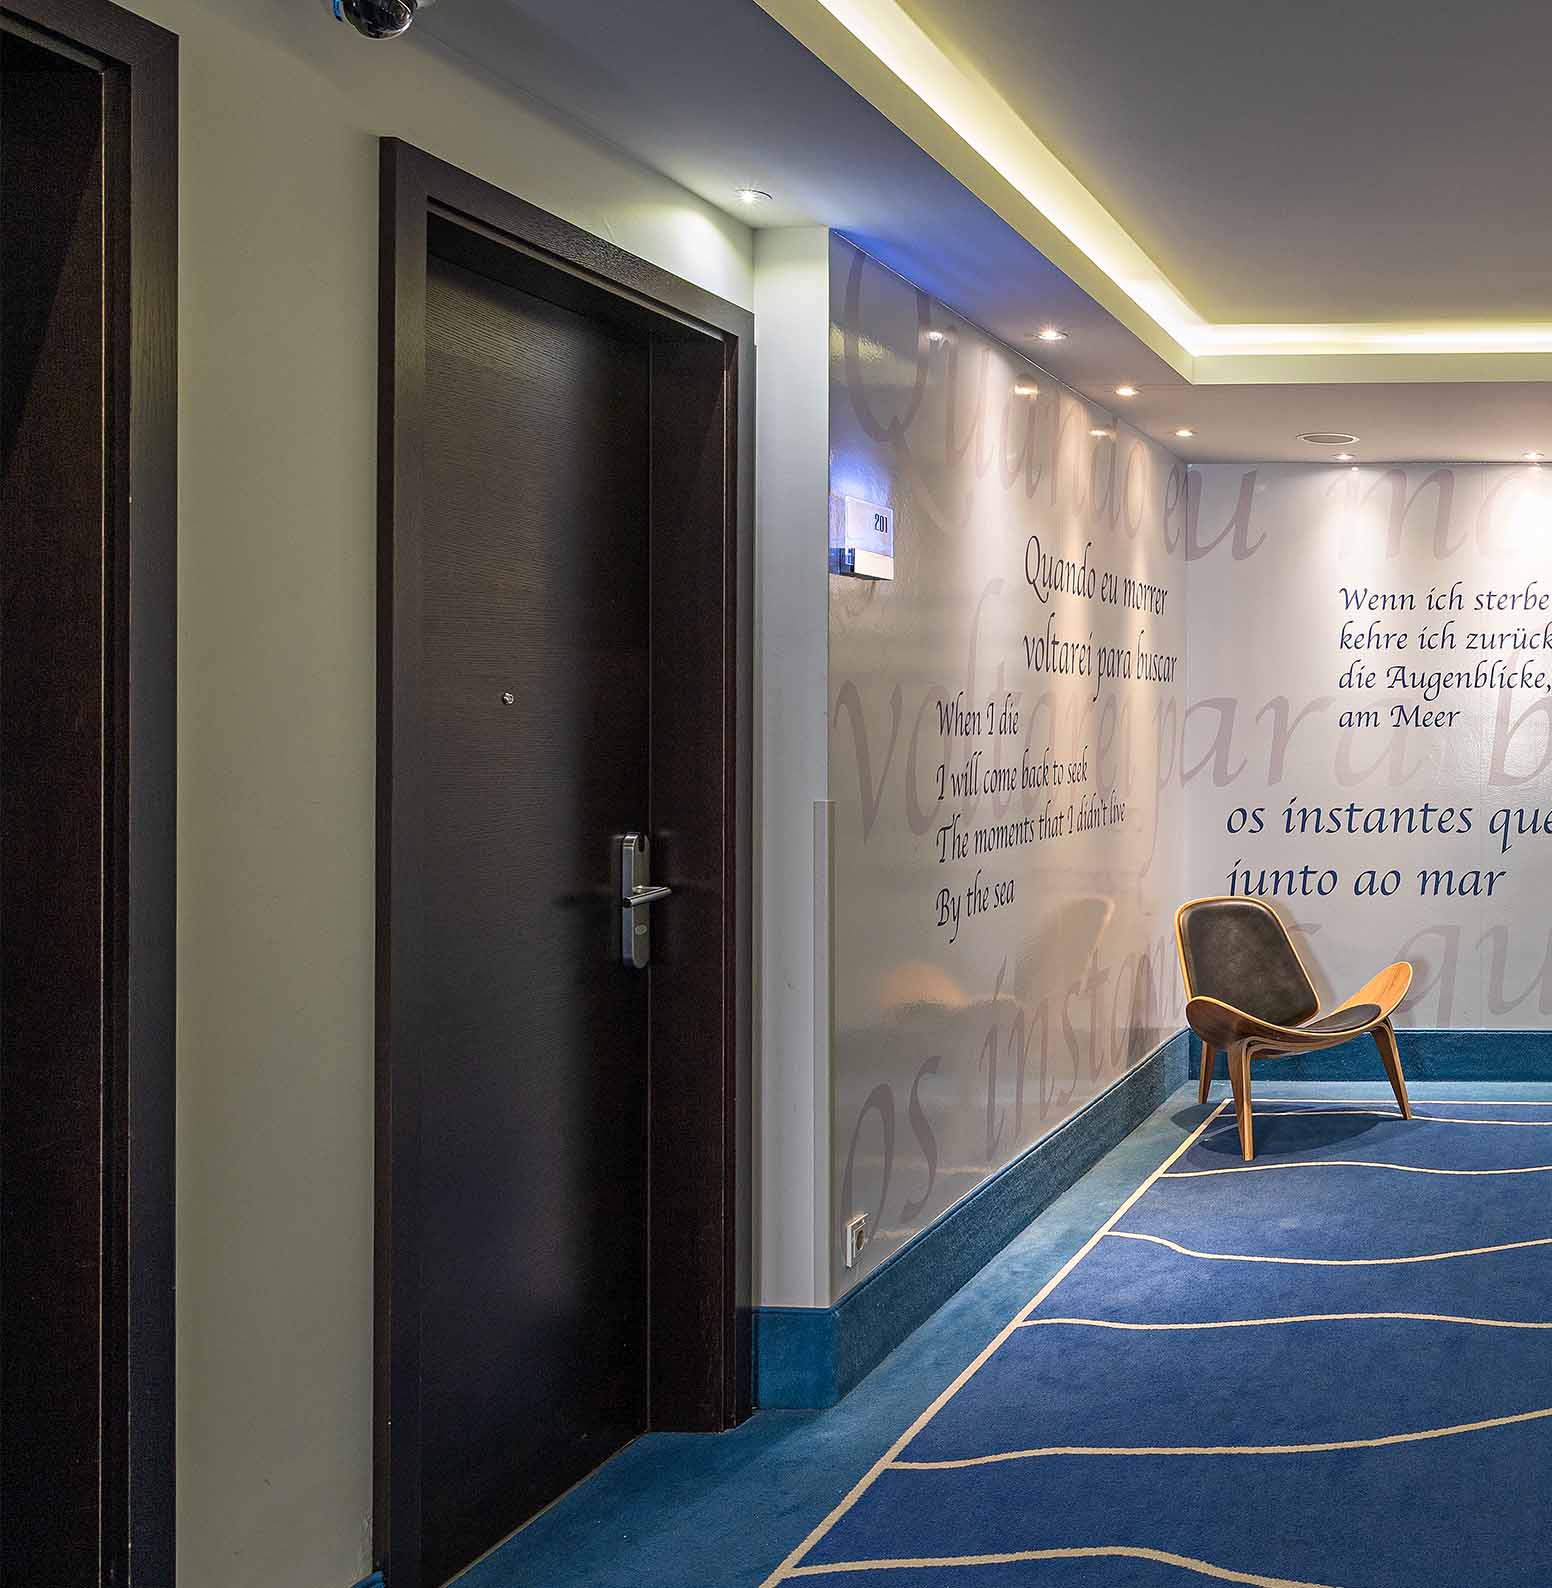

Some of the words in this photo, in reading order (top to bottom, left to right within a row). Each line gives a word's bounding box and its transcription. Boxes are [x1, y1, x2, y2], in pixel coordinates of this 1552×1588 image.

[843, 252, 1152, 539] Quando
[1163, 463, 1269, 563] eu
[874, 513, 888, 534] 201
[1025, 535, 1096, 604] Quando
[1101, 572, 1119, 605] eu
[1123, 576, 1168, 616] morrer
[1339, 587, 1416, 611] Wenn
[1426, 580, 1464, 611] ich
[1473, 580, 1550, 611] sterbe
[1023, 612, 1093, 676] voltarei
[1094, 646, 1132, 701] para
[1136, 629, 1178, 683] buscar
[1339, 619, 1409, 650] kehre
[1418, 619, 1457, 650] ich
[1338, 659, 1377, 689] die
[1386, 659, 1552, 702] Augenblicke,
[833, 577, 1137, 846] voltarei
[1140, 690, 1443, 877] para
[936, 691, 982, 737] When
[986, 701, 995, 736] I
[999, 692, 1019, 736] die
[1338, 710, 1380, 729] am
[1390, 704, 1462, 729] Meer
[936, 764, 945, 801] I
[950, 751, 983, 798] will
[983, 767, 1018, 795] come
[1021, 747, 1050, 790] back
[1052, 758, 1064, 786] to
[1066, 745, 1088, 784] seek
[936, 812, 969, 863] The
[974, 815, 1035, 856] moments
[1038, 799, 1065, 841] that
[1067, 804, 1074, 835] I
[1076, 792, 1108, 833] didn't
[1109, 789, 1126, 826] live
[1226, 806, 1266, 834] os
[1281, 796, 1473, 834] instantes
[1225, 858, 1339, 897] junto
[1353, 869, 1401, 897] ao
[1416, 869, 1507, 897] mar
[936, 887, 961, 944] By
[966, 869, 990, 917] the
[993, 879, 1015, 911] sea
[841, 1056, 941, 1248] os
